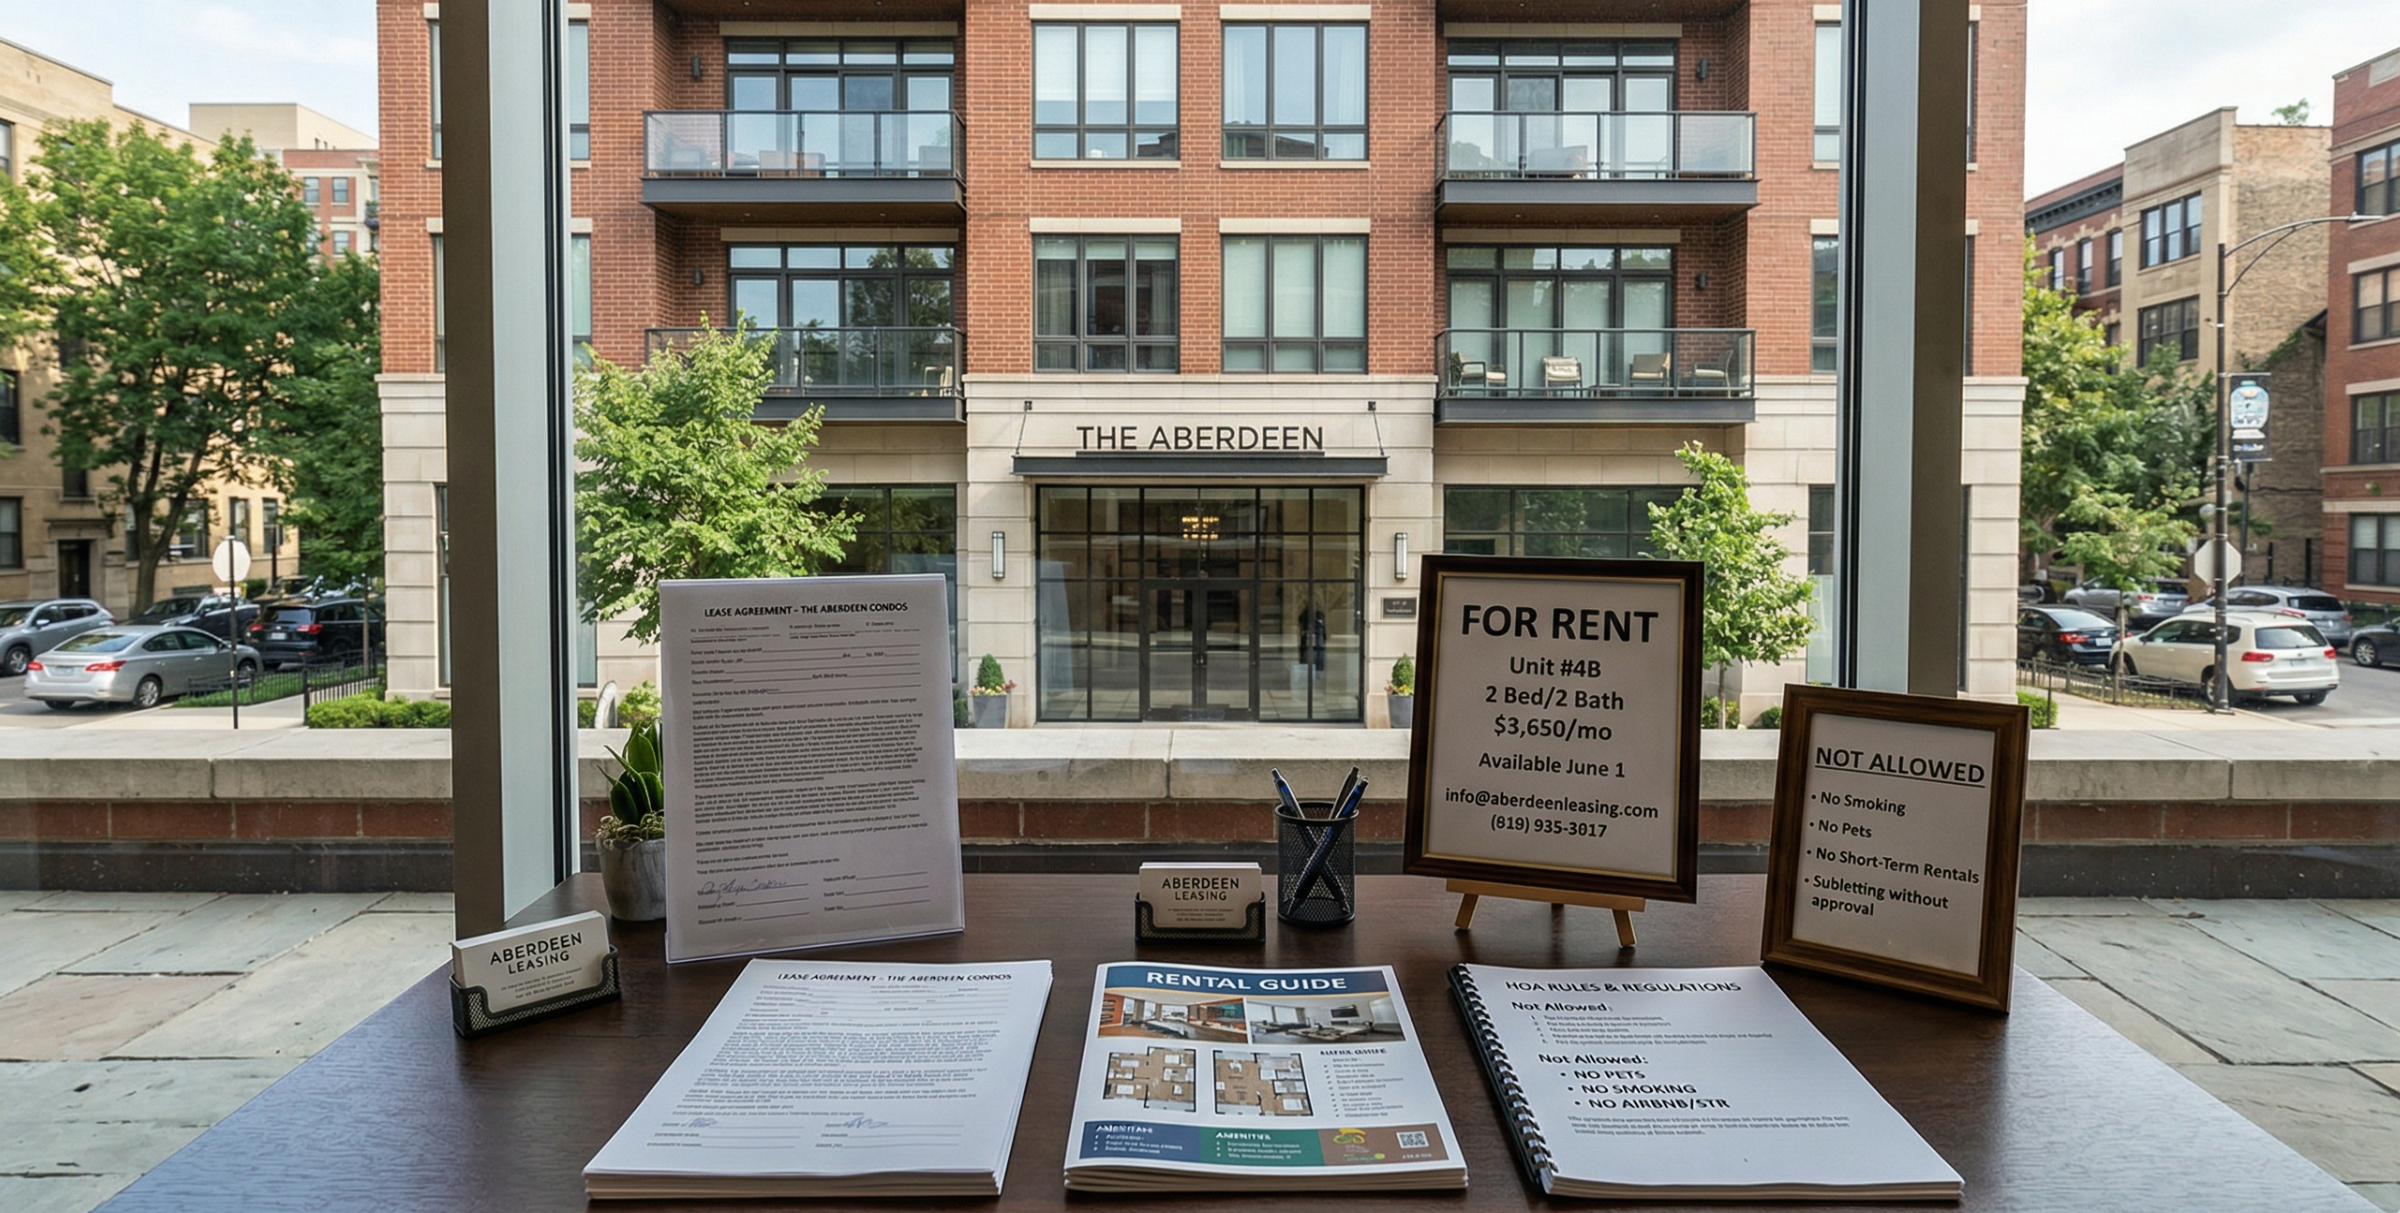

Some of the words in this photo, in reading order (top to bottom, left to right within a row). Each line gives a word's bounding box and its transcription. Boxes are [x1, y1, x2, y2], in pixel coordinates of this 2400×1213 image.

[1076, 426, 1138, 450] THE
[1148, 426, 1323, 450] ABERDEEN
[704, 608, 732, 617] LEASE
[734, 606, 793, 616] AGREEMENT
[801, 605, 818, 614] THE
[820, 604, 867, 613] ABERDEEN
[869, 603, 908, 612] CONDOS
[1462, 604, 1538, 638] FOR
[1552, 608, 1658, 642] RENT
[1510, 656, 1554, 676] Unit
[1560, 660, 1601, 678] #4B
[1486, 686, 1497, 702] 2
[1504, 686, 1568, 709] Bed/2
[1574, 691, 1624, 710] Bath
[1494, 714, 1612, 741] $3,650/mo
[1479, 752, 1561, 773] Available
[1566, 759, 1608, 776] June
[1616, 762, 1625, 777] 1
[1816, 747, 1864, 769] NOT
[1869, 753, 1984, 783] ALLOWED
[1445, 788, 1658, 818] info@aberdeenleasing.com
[1821, 792, 1840, 805] No
[1845, 794, 1906, 816] Smoking
[1491, 814, 1529, 834] (819)
[1534, 819, 1607, 837] 935-3017
[1818, 820, 1838, 833] No
[1842, 822, 1872, 838] Pets
[1816, 847, 1836, 861] No
[1840, 851, 1919, 874] Short-Term
[1924, 864, 1979, 883] Rentals
[1162, 878, 1239, 889] ABERDEEN
[1813, 875, 1885, 900] Subletting
[1889, 889, 1949, 909] without
[1175, 891, 1227, 900] LEASING
[1811, 897, 1874, 916] approval
[490, 932, 582, 965] ABERDEEN
[508, 951, 569, 974] LEASING
[1147, 971, 1251, 990] RENTAL
[1259, 978, 1347, 990] GUIDE
[1505, 981, 1545, 992] HOA
[1548, 982, 1602, 992] RULES
[1605, 982, 1620, 992] &
[1623, 982, 1742, 992] REGULATIONS
[1511, 1001, 1541, 1012] Not
[1545, 1002, 1614, 1012] Allowed:
[1538, 1054, 1571, 1064] Not
[1574, 1055, 1649, 1065] Allowed:
[1574, 1070, 1600, 1079] NO
[1605, 1070, 1646, 1079] PETS
[1582, 1085, 1608, 1094] NO
[1613, 1084, 1697, 1094] SMOKING
[1589, 1099, 1617, 1109] NO
[1622, 1099, 1731, 1110] AIRBNB/STR
